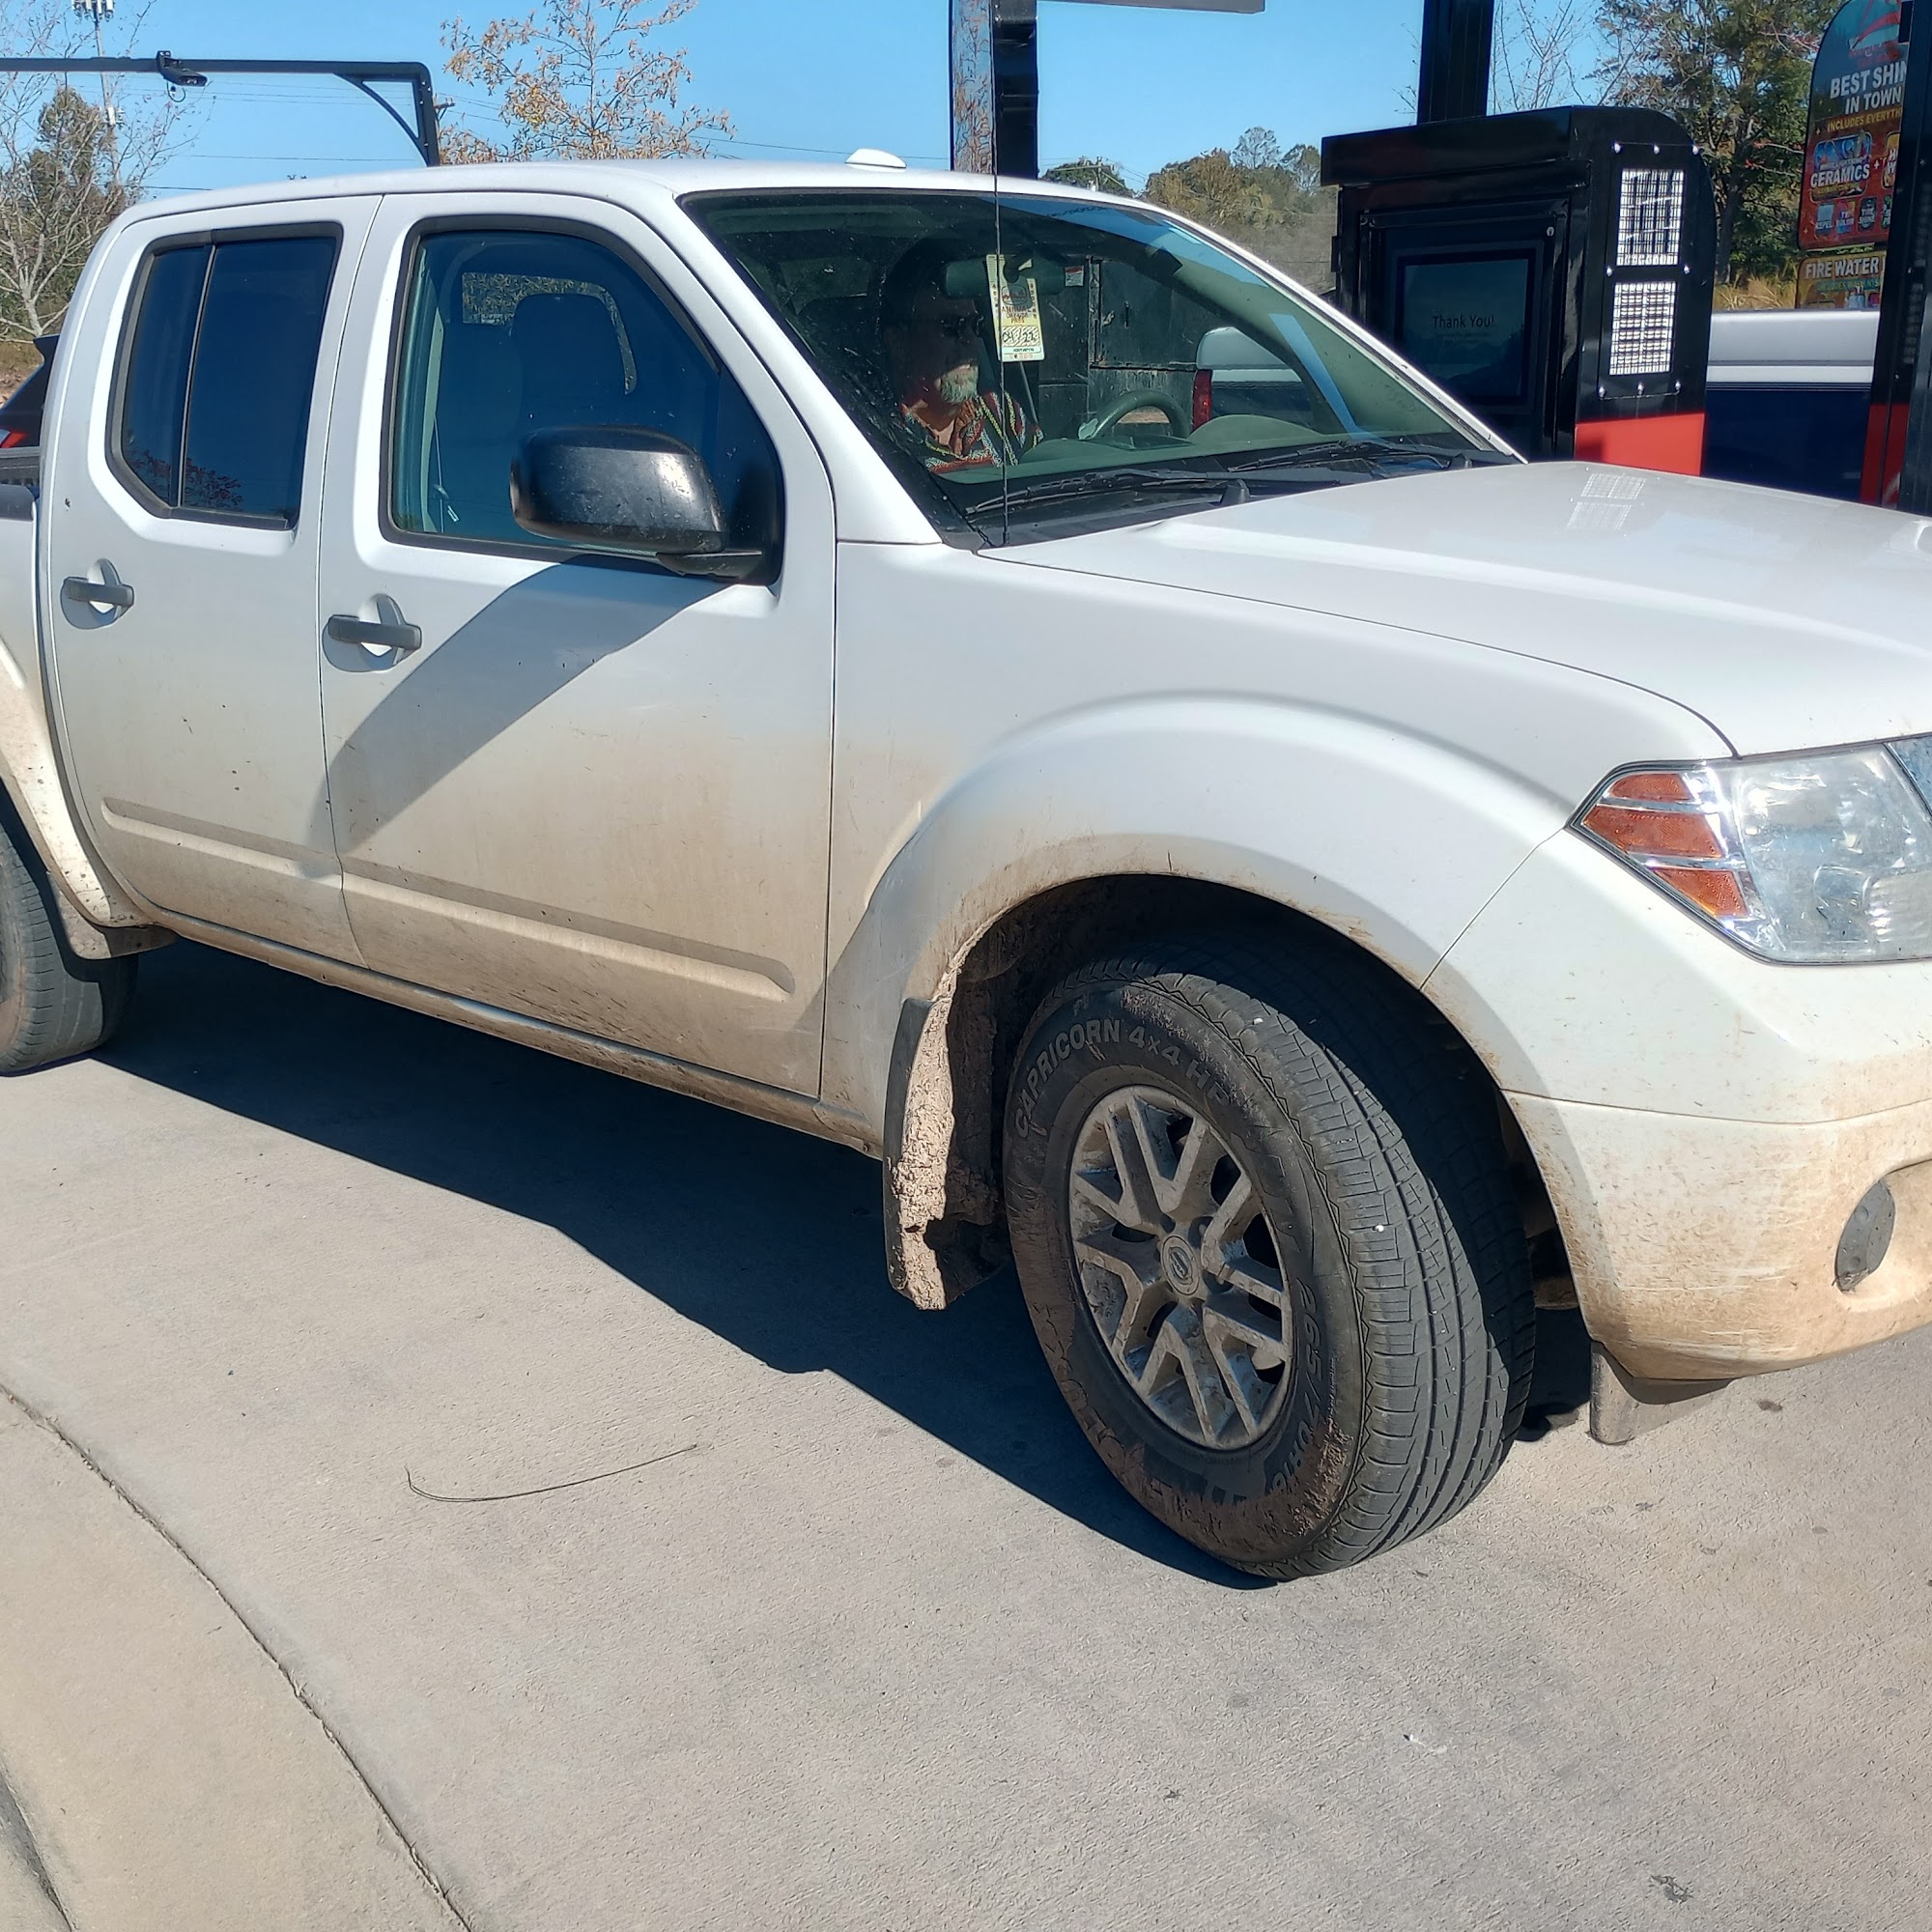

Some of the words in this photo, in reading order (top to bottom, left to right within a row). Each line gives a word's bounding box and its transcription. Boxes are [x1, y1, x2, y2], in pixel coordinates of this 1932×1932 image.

[1830, 70, 1870, 99] BEST
[1844, 97, 1860, 115] IN
[1863, 85, 1902, 111] TOWN
[1827, 115, 1864, 132] INCLUDES
[1810, 163, 1870, 188] CERAMICS
[1805, 262, 1833, 279] FIRE
[1835, 256, 1879, 277] WATER
[1433, 314, 1466, 328] Thank
[1469, 314, 1494, 327] You!
[1015, 1017, 1121, 1138] CAPRICORN
[1186, 1059, 1230, 1107] HP
